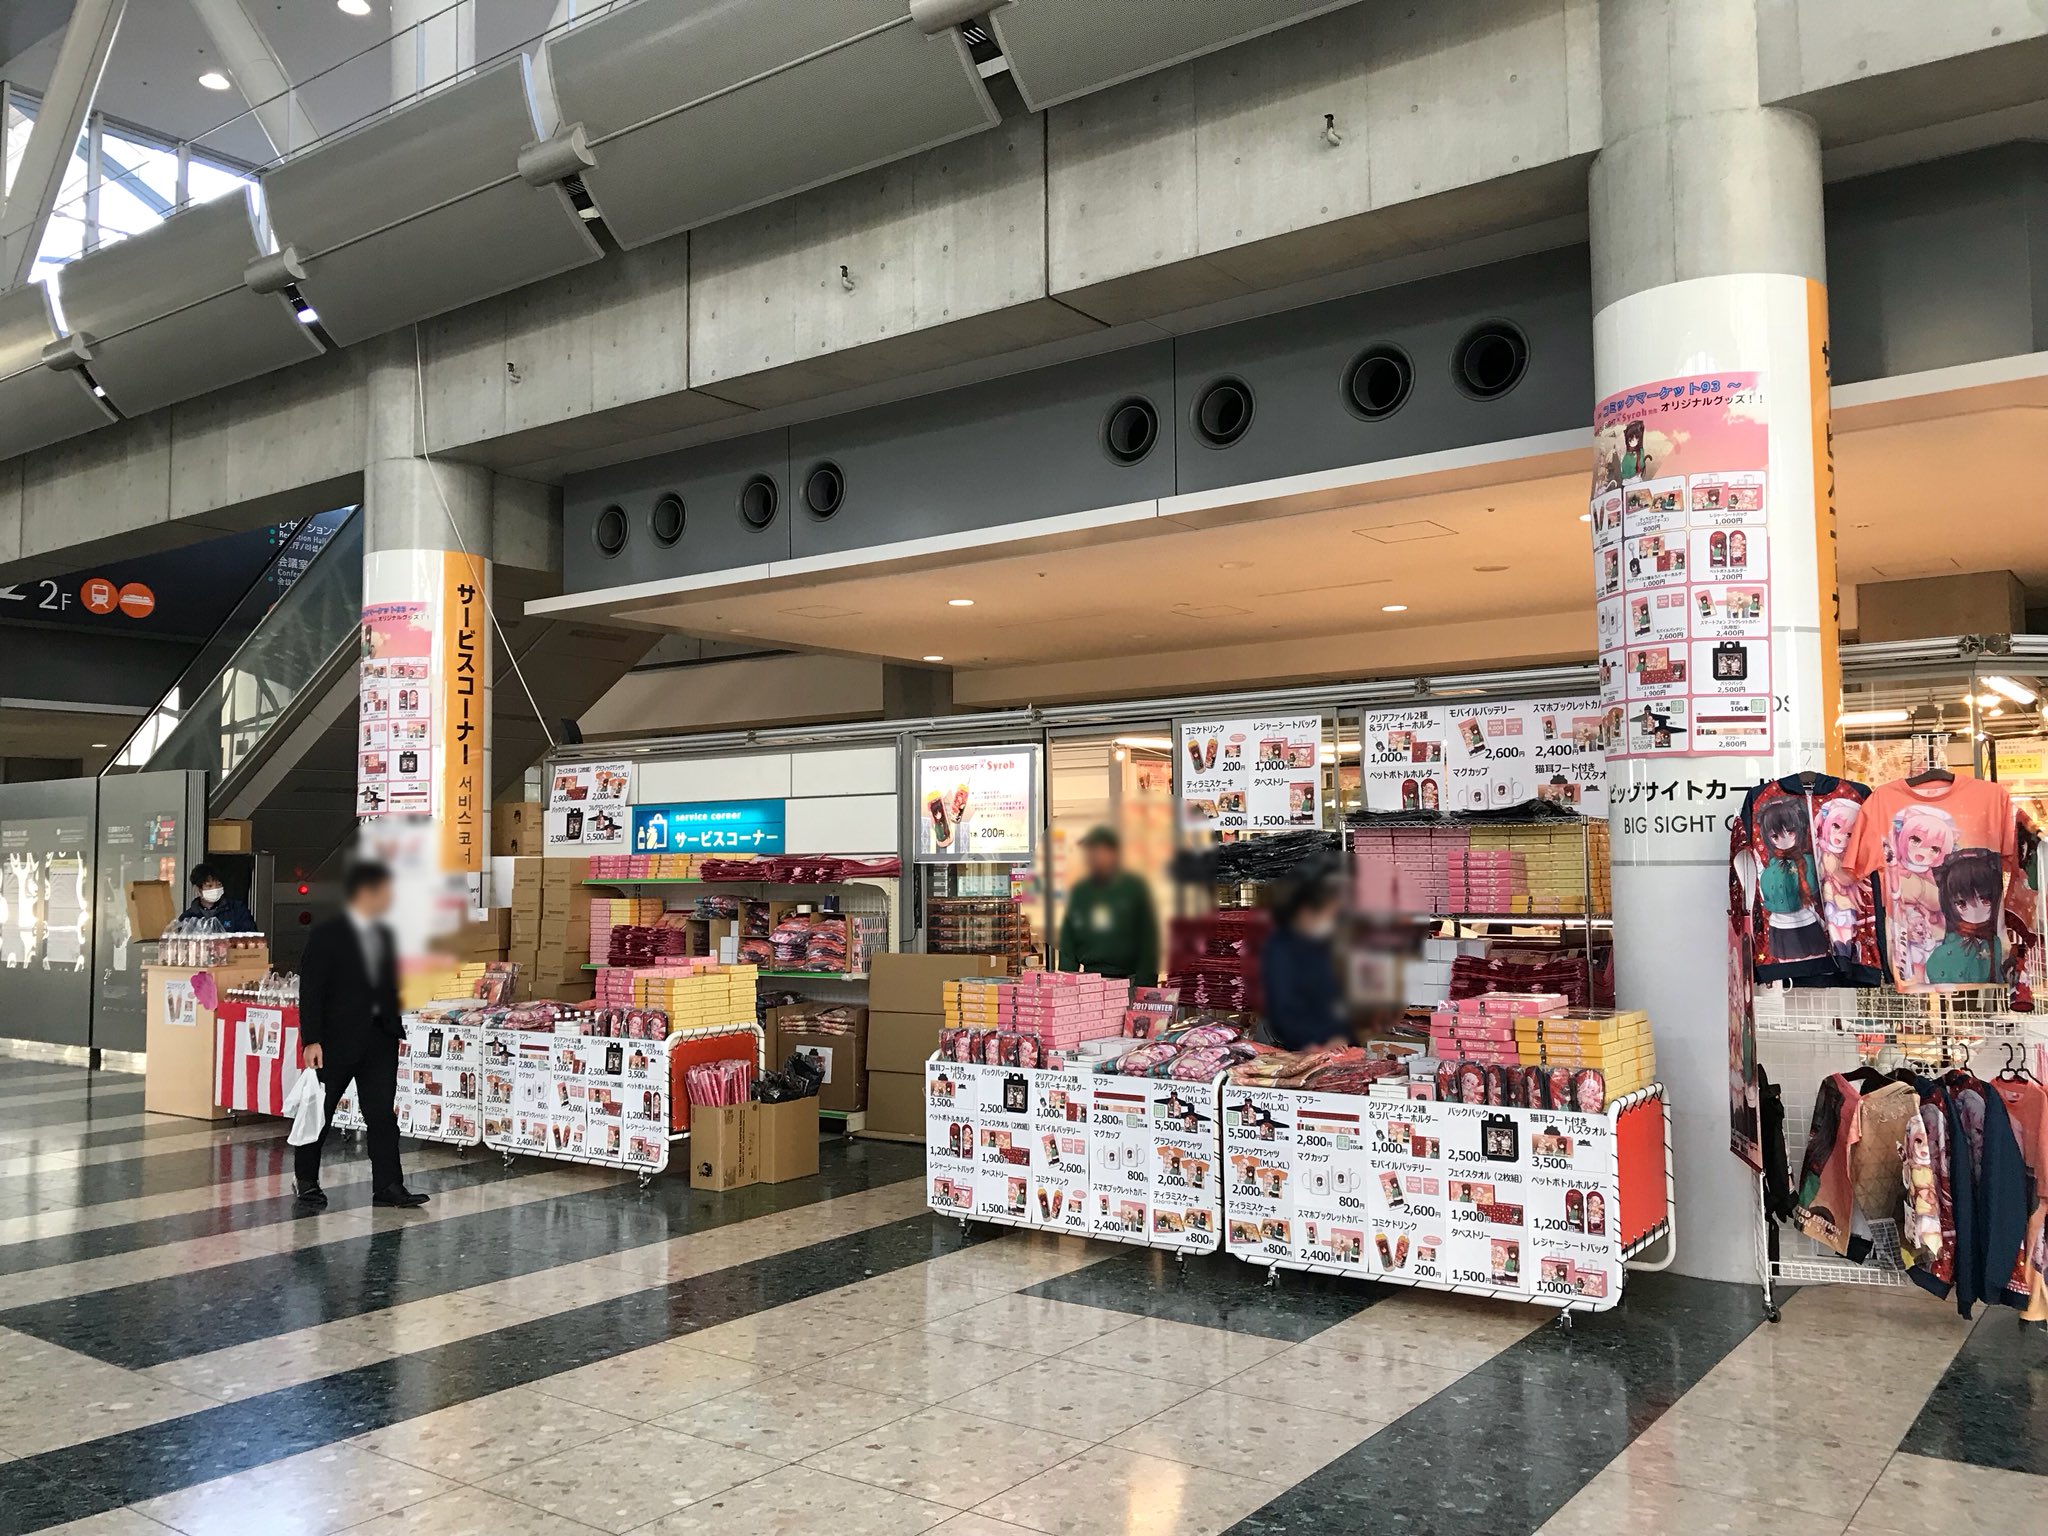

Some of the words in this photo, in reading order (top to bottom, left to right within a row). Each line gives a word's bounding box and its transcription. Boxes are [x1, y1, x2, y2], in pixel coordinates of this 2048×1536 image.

[39, 580, 72, 611] 2F
[1658, 632, 1684, 640] 2,600円
[457, 584, 476, 764] サービスコーナー
[1370, 710, 1428, 724] クリアファイル2種
[1449, 706, 1515, 718] モバイルバッテリー
[1186, 724, 1225, 735] コミケドリンク
[1253, 719, 1317, 731] レジャーシートバッグ
[1369, 720, 1440, 732] &ラバーキーホルダー
[1484, 746, 1525, 761] 2,600円
[1536, 744, 1579, 757] 2,400円
[1371, 752, 1408, 764] 1,000円
[987, 760, 1014, 772] Syroh
[1222, 761, 1246, 772] 200円
[1254, 760, 1290, 772] 1,000円
[1453, 766, 1490, 777] マグカップ
[1535, 762, 1595, 774] 猫耳フード付き
[1370, 769, 1440, 780] ペットボトルホルダー
[1186, 779, 1234, 789] ティラミスケーキ
[1254, 778, 1290, 786] タペストリー
[675, 812, 708, 822] service
[710, 812, 742, 820] corner
[1254, 816, 1290, 826] 1,500円
[1624, 816, 1647, 834] BIG
[1654, 815, 1716, 834] SIGHT
[674, 829, 778, 848] サービスコーナー
[982, 828, 1004, 838] 200円
[1132, 1002, 1147, 1010] 2017
[1148, 1003, 1173, 1012] WINTER
[930, 1064, 964, 1073] 猫耳フード付き
[982, 1068, 1009, 1077] バックパック
[1035, 1073, 1078, 1084] クリアファイル2種
[1035, 1081, 1087, 1091] &ラバーキーホルダー
[446, 1090, 462, 1098] 1,200
[1226, 1089, 1289, 1100] フルグラフィックパーカー
[1295, 1095, 1321, 1104] マフラー
[930, 1097, 954, 1108] 3,500円
[1368, 1101, 1426, 1114] クリアファイル2種
[626, 1112, 648, 1120] 1,200
[1369, 1111, 1439, 1123] &ラバーキーホルダー
[1448, 1107, 1489, 1118] バックパック
[1094, 1114, 1123, 1126] 2,800円
[1530, 1113, 1587, 1127] 猫耳フード付き
[1035, 1124, 1081, 1135] モバイルバッテリー
[1094, 1130, 1121, 1140] マグカップ
[1154, 1136, 1202, 1149] グラフィックTシャツ
[1296, 1135, 1333, 1148] 2,800円
[1227, 1145, 1280, 1158] グラフィックTシャツ
[1372, 1142, 1408, 1155] 1,000円
[1298, 1152, 1330, 1163] マグカップ
[1448, 1149, 1488, 1164] 2,500円
[930, 1162, 974, 1174] レジャーシートバッグ
[1059, 1162, 1086, 1175] 2,600円
[1370, 1160, 1432, 1172] モバイルバッテリー
[1532, 1156, 1573, 1171] 3,500円
[1036, 1175, 1069, 1186] コミケドリンク
[1128, 1171, 1148, 1182] 800円
[1448, 1168, 1523, 1184] フェイスタオル（2枚組）
[1531, 1176, 1607, 1190] ペットボトルホルダー
[1093, 1183, 1147, 1196] スマホブックレットカバー
[1232, 1184, 1265, 1197] 2,000円
[1154, 1190, 1200, 1203] ティラミスケーキ
[1228, 1201, 1277, 1213] ティラミスケーキ
[1338, 1196, 1365, 1210] 800円
[1298, 1210, 1364, 1224] スマホブックレットカバー
[1404, 1204, 1441, 1218] 2,600円
[1451, 1209, 1491, 1224] 1,900円
[1065, 1215, 1085, 1227] 200円
[1372, 1218, 1418, 1231] コミケドリンク
[1533, 1218, 1575, 1233] 1,200円
[1451, 1228, 1491, 1239] タペストリー
[1532, 1237, 1609, 1254] レジャーシートバッグ
[1300, 1249, 1336, 1263] 2,400円
[1414, 1264, 1441, 1279] 200円
[1452, 1269, 1492, 1284] 1,500円
[1536, 1281, 1578, 1296] 1,000円
